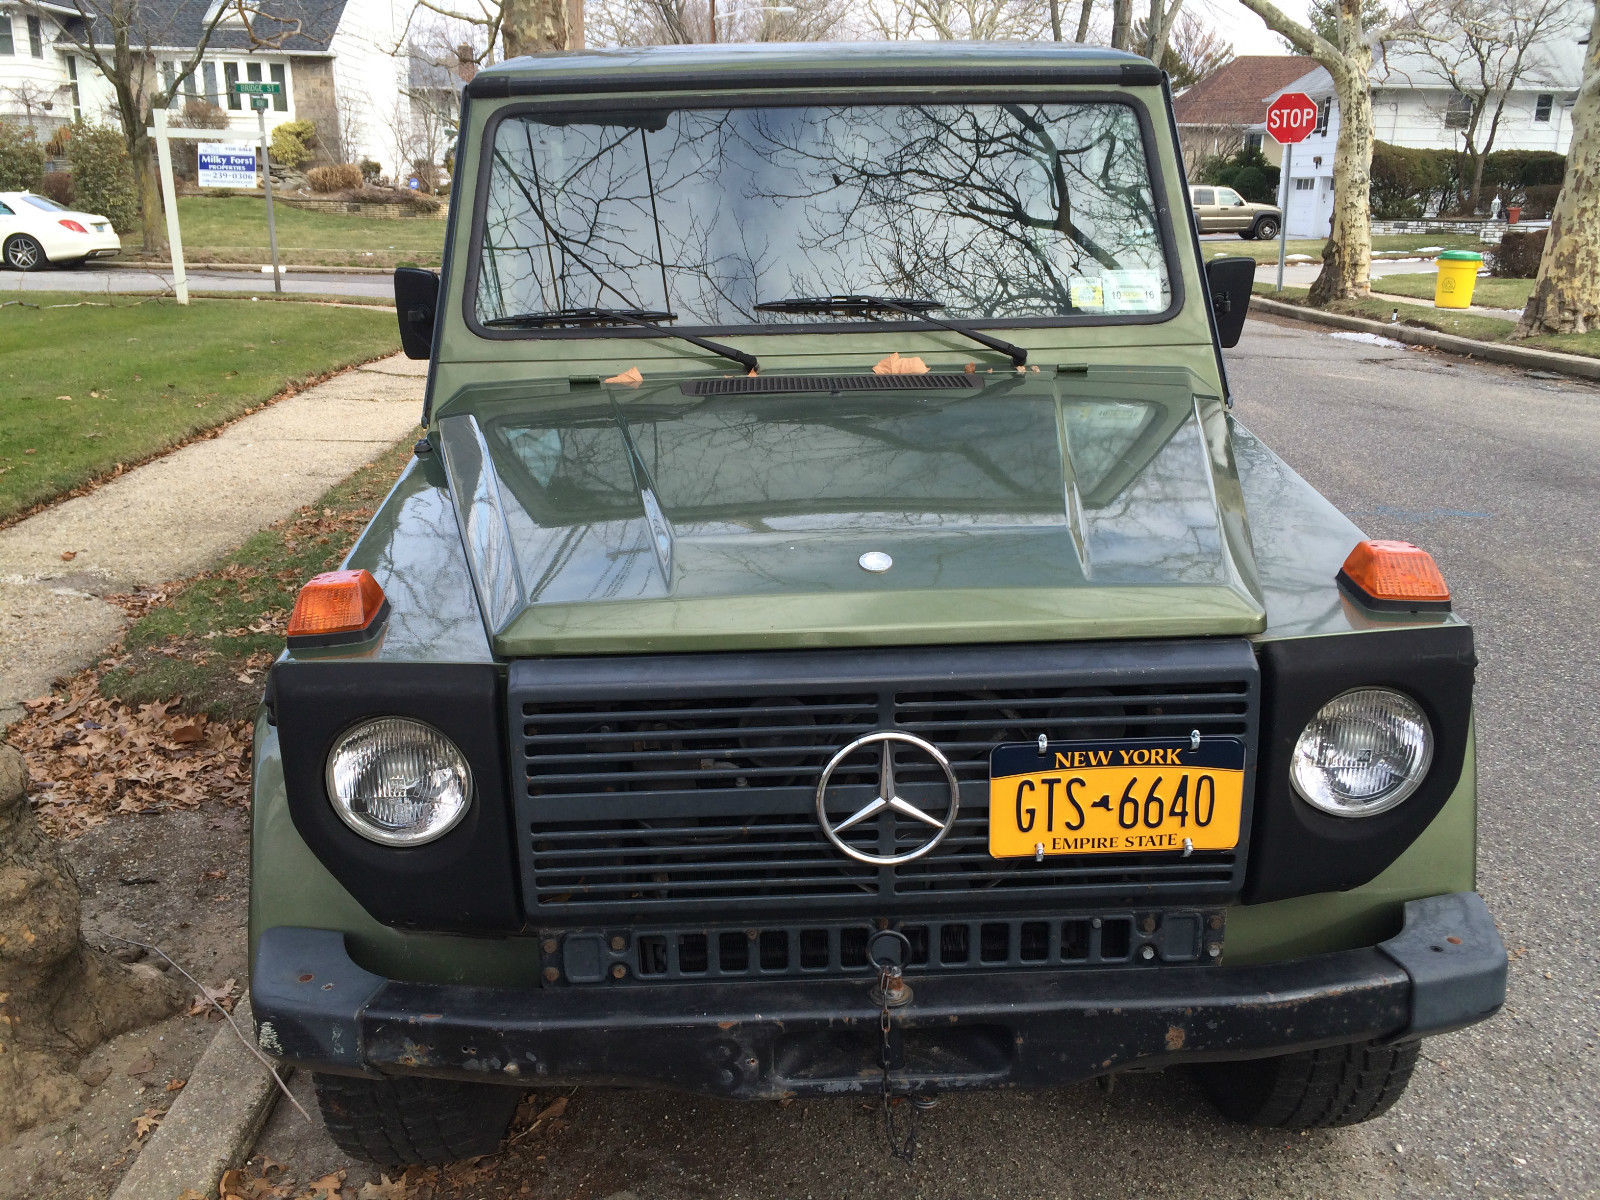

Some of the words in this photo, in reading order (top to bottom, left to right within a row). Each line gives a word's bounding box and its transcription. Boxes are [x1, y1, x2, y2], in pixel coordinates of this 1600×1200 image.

[240, 84, 262, 92] BRIDGE
[266, 84, 275, 92] ST
[1269, 108, 1314, 129] STOP
[201, 155, 227, 165] Milky
[230, 156, 253, 165] Forst
[1055, 750, 1113, 769] NEW
[1119, 748, 1182, 766] YORK
[1051, 836, 1118, 850] EMPIRE
[1124, 833, 1178, 848] STATE
